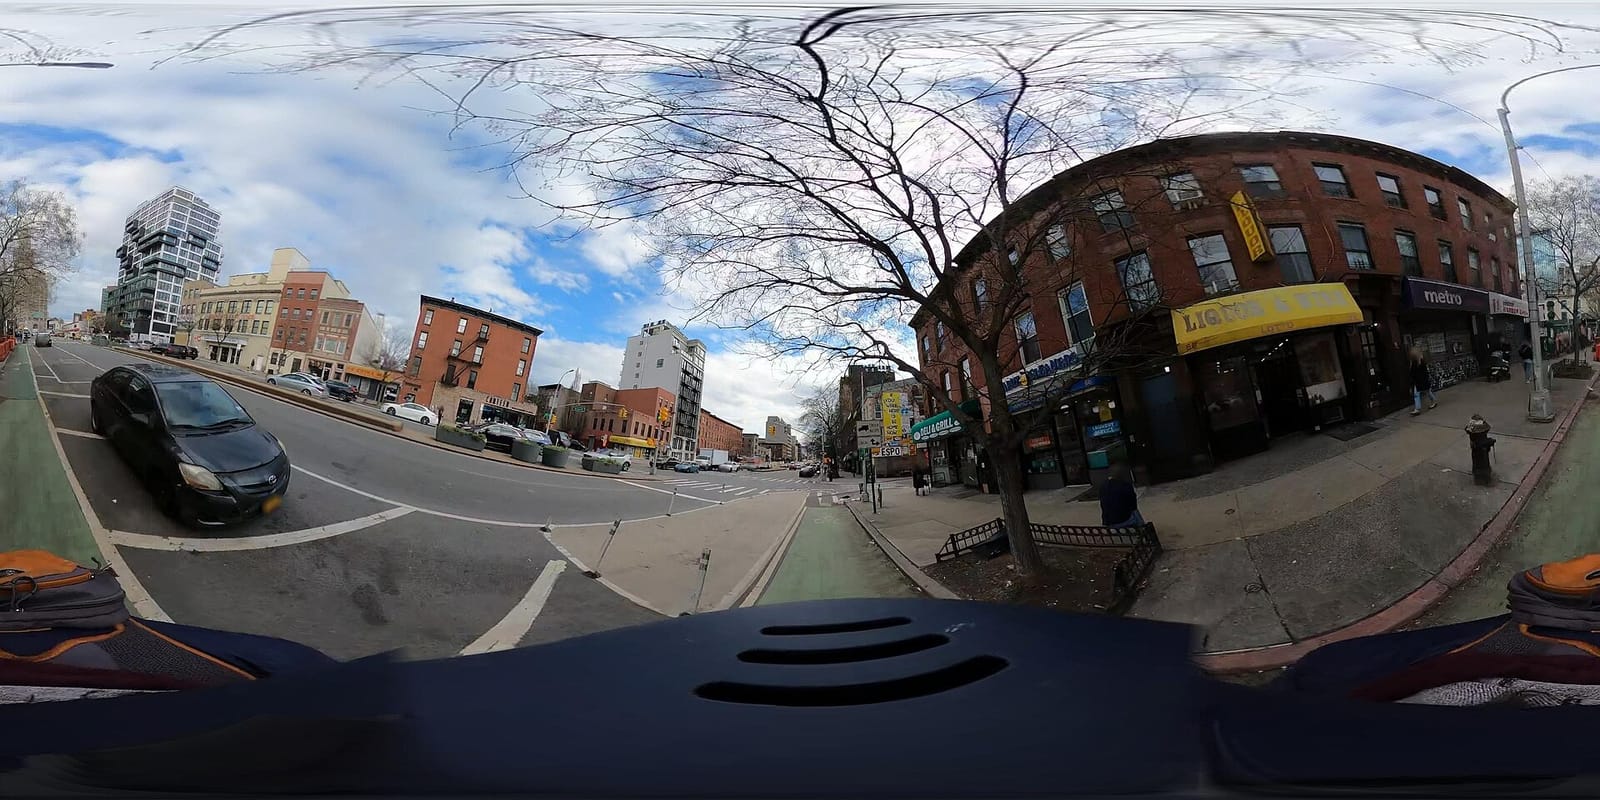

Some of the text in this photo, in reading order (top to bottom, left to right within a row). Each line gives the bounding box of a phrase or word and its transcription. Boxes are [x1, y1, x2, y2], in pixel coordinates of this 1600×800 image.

[1424, 290, 1463, 305] metro
[920, 424, 931, 437] DELI
[935, 417, 954, 432] GRILL
[881, 447, 901, 456] ESPO
